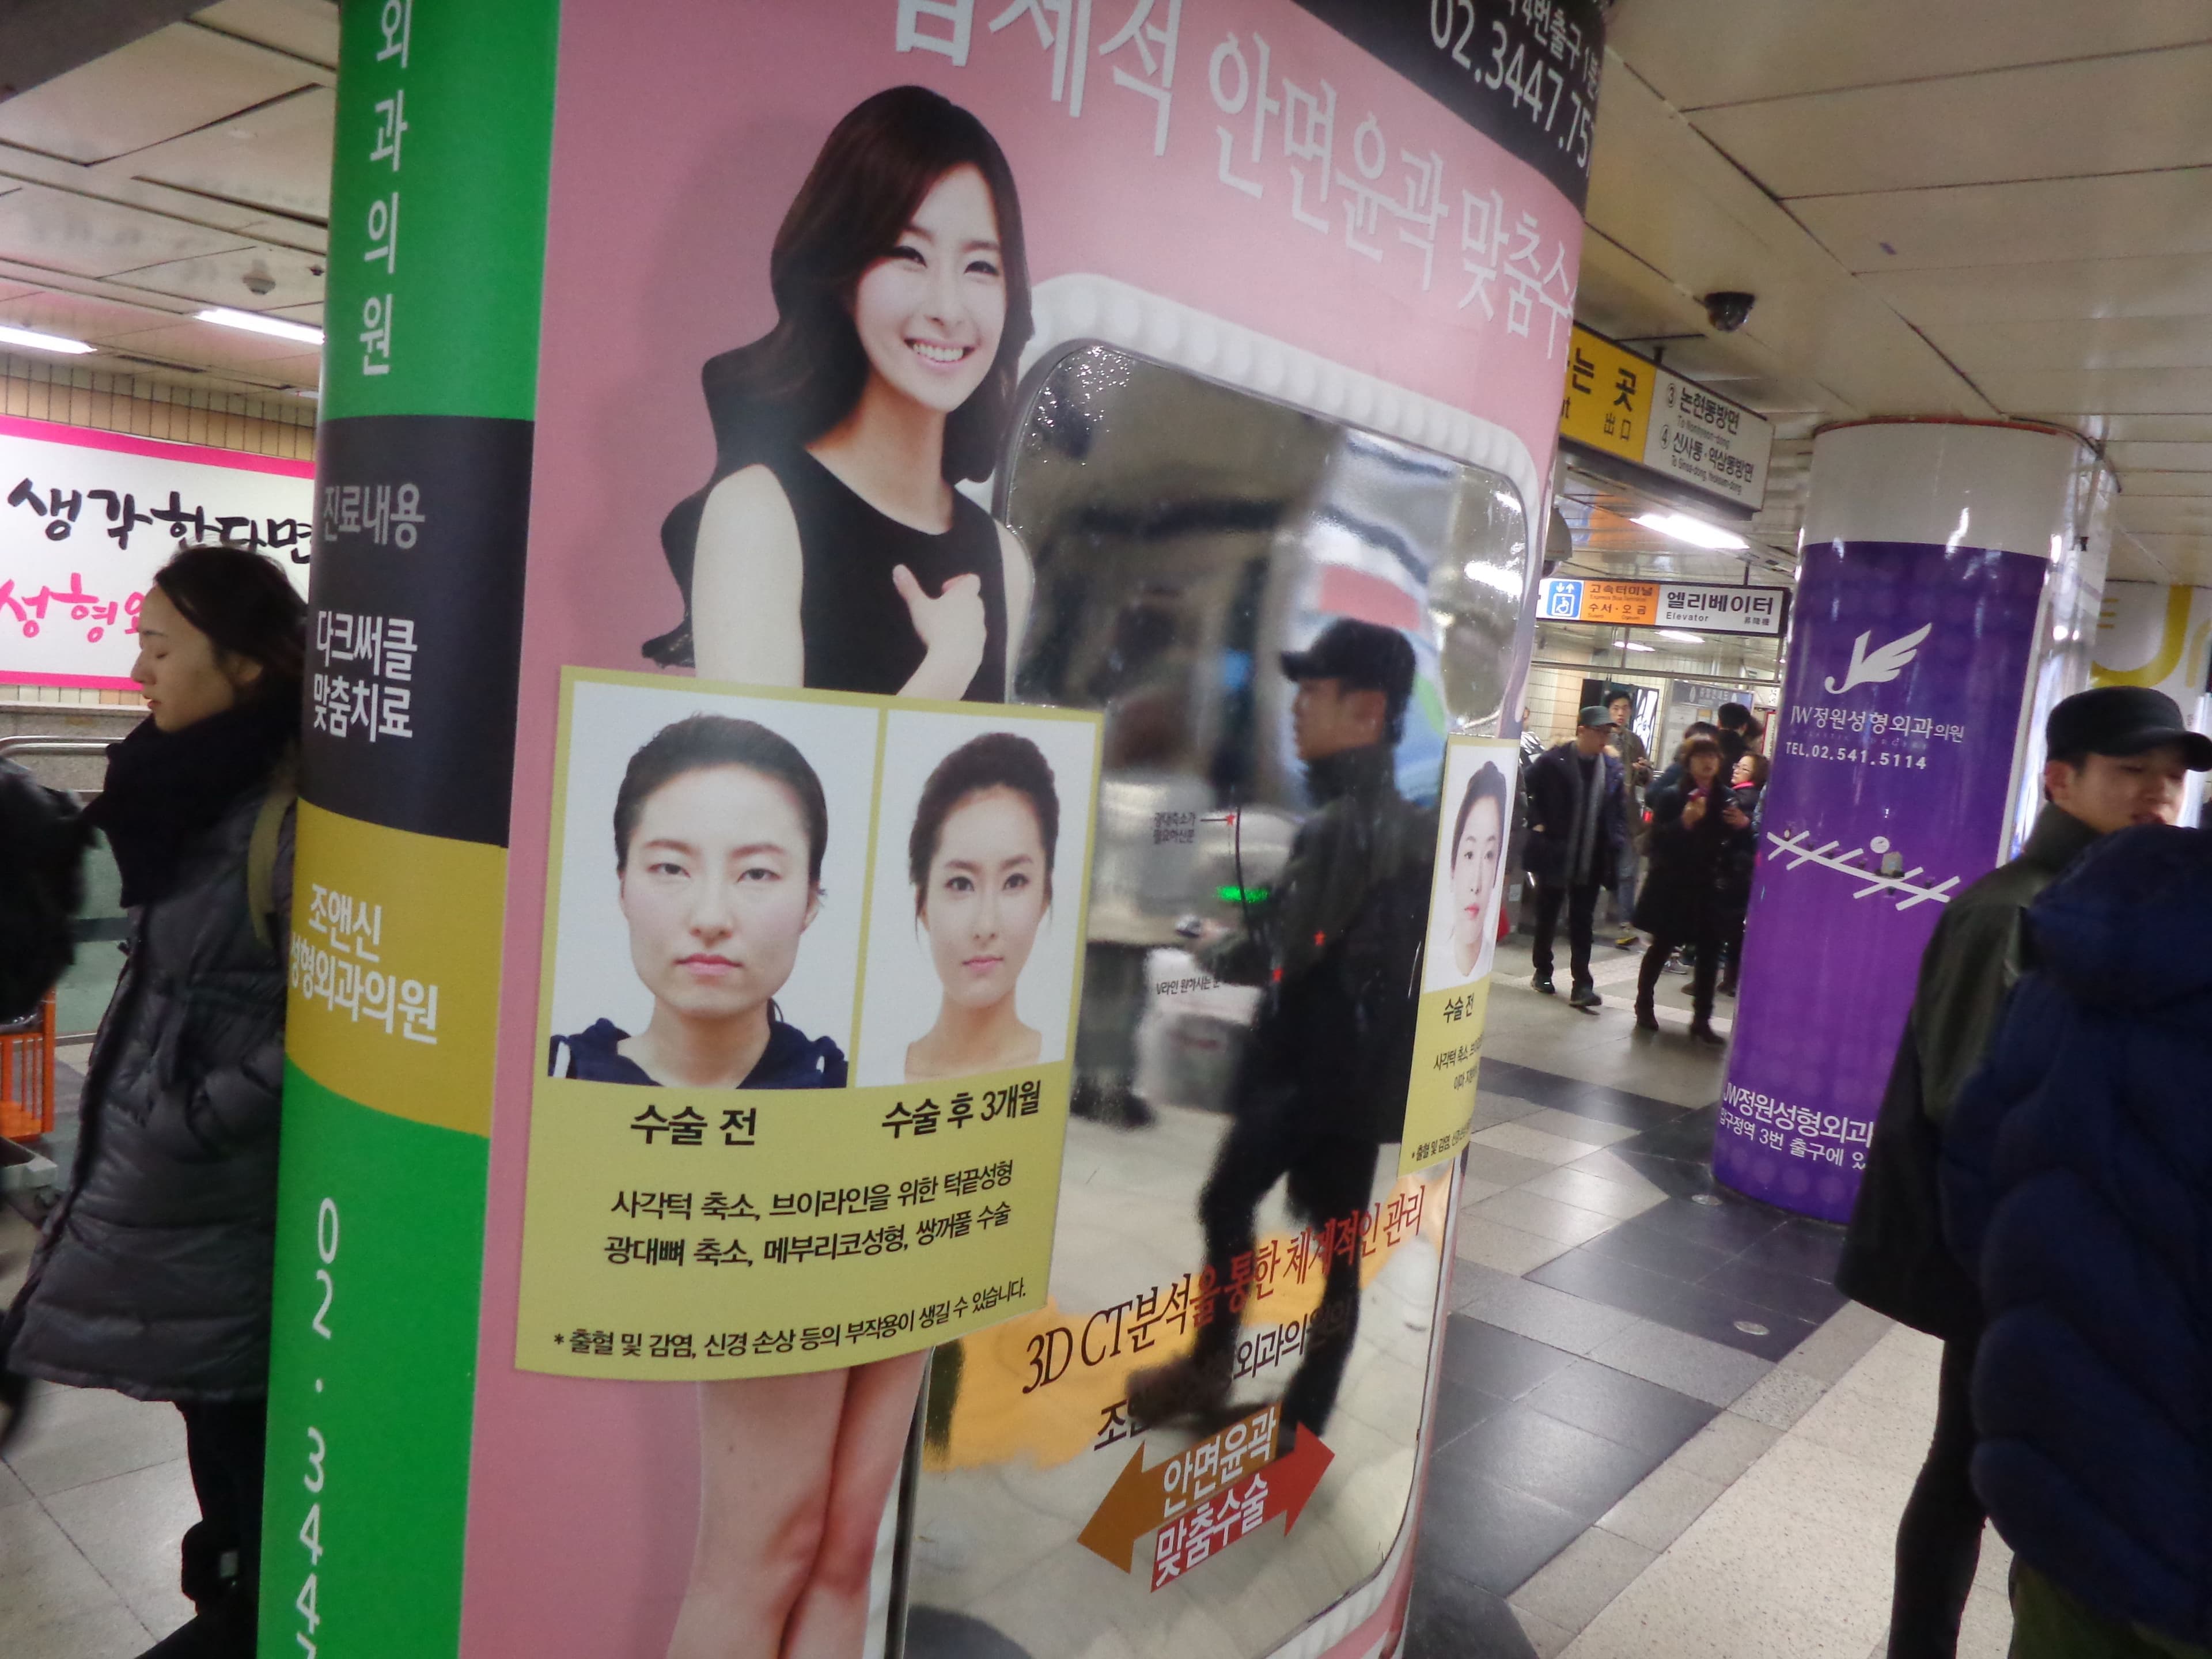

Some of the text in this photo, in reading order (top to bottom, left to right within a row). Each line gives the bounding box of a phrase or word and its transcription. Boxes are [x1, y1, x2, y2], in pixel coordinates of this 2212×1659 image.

[1430, 0, 1593, 173] 02.3447.75
[1209, 31, 1577, 361] 안면윤곽 맞춤수
[1567, 347, 1637, 412] 는 곳
[1603, 412, 1631, 441] 出口
[323, 482, 426, 550] 진료내용
[1589, 584, 1653, 597] 고속터미널
[1666, 612, 1709, 622] Elevator
[1667, 592, 1774, 615] 엘리베이터
[317, 611, 418, 681] 다크써클
[313, 673, 413, 743] 맞춤치료
[1786, 741, 1927, 770] TEL.02.541.5114
[309, 883, 382, 963] 조앤신
[291, 931, 438, 1044] 성형외과의원
[1442, 992, 1475, 1024] 수술 전
[630, 1104, 757, 1146] 수술 전
[881, 1079, 1042, 1139] 수술 후 3개월
[1759, 1128, 1784, 1151] 3번
[1789, 1137, 1844, 1167] 출구에
[611, 1159, 1014, 1221] 사각턱 축소, 브이라인을 위한 턱끝성형
[604, 1200, 1012, 1267] 광대뼈 축소, 메부리코성형, 쌍꺼풀 수술
[569, 1277, 1027, 1359] 출혈 및 감염, 신경 손상 등의 부작용이 생길 수 있습니다.
[1022, 1185, 1426, 1394] 3D CT분석을 통한 체계적인 관리
[1162, 1404, 1278, 1519] 안면윤곽
[1155, 1474, 1268, 1588] 맞춤수술
